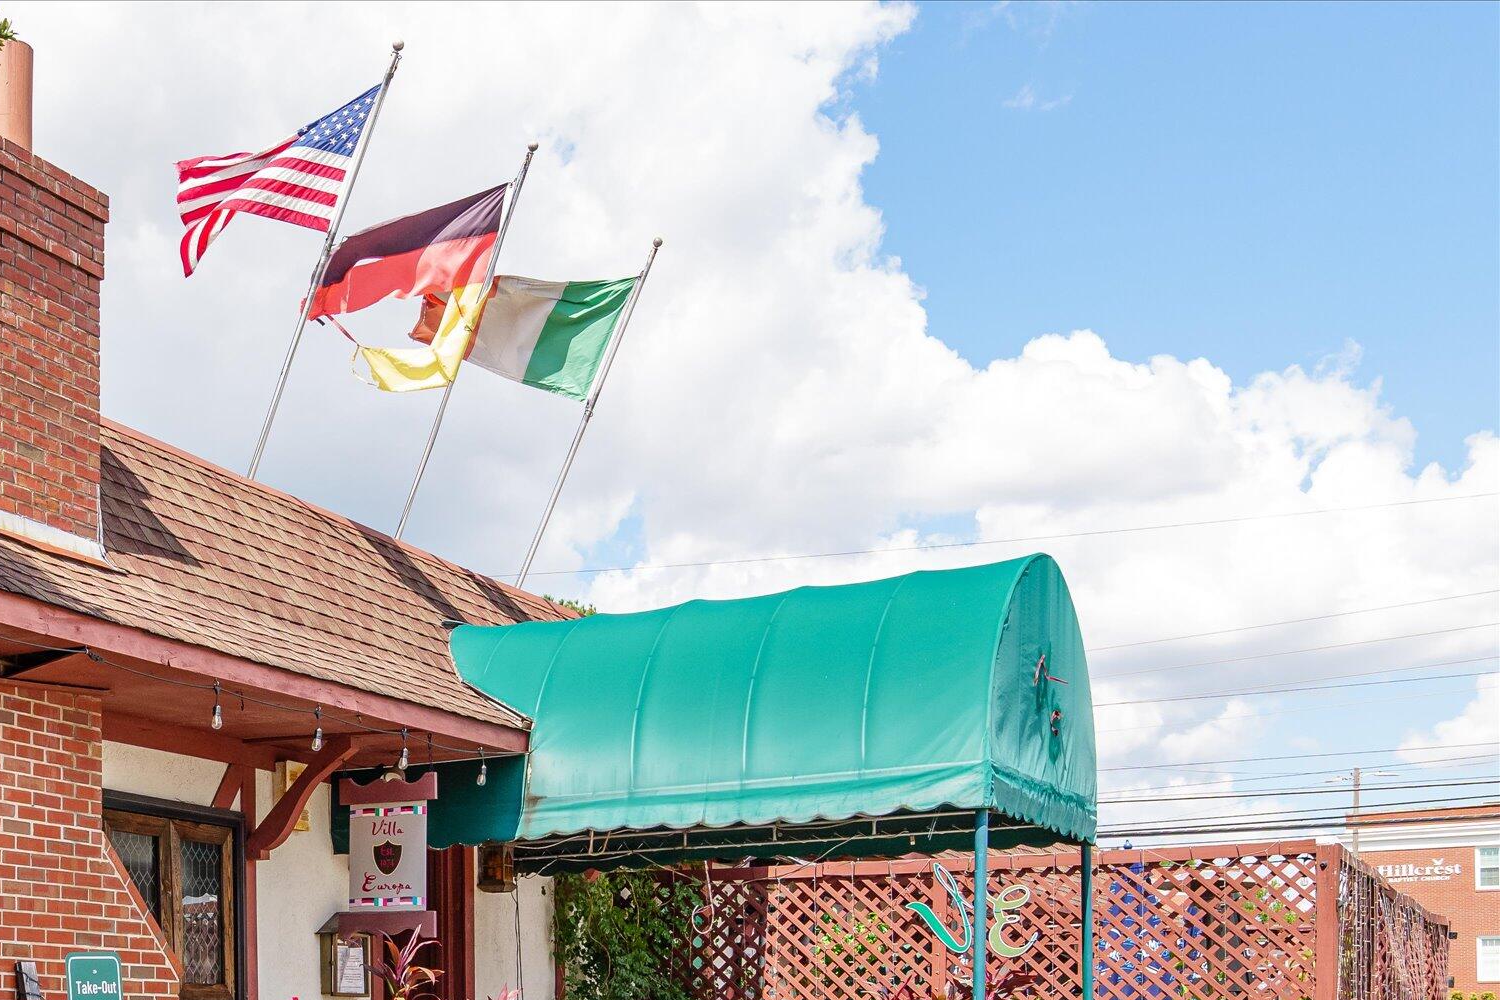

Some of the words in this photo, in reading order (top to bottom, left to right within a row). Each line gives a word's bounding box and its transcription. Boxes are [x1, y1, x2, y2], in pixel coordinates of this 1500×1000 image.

[371, 819, 404, 836] Villa
[1376, 863, 1462, 877] Hillcrest
[362, 872, 411, 894] Europa
[76, 980, 117, 995] Take-Out
